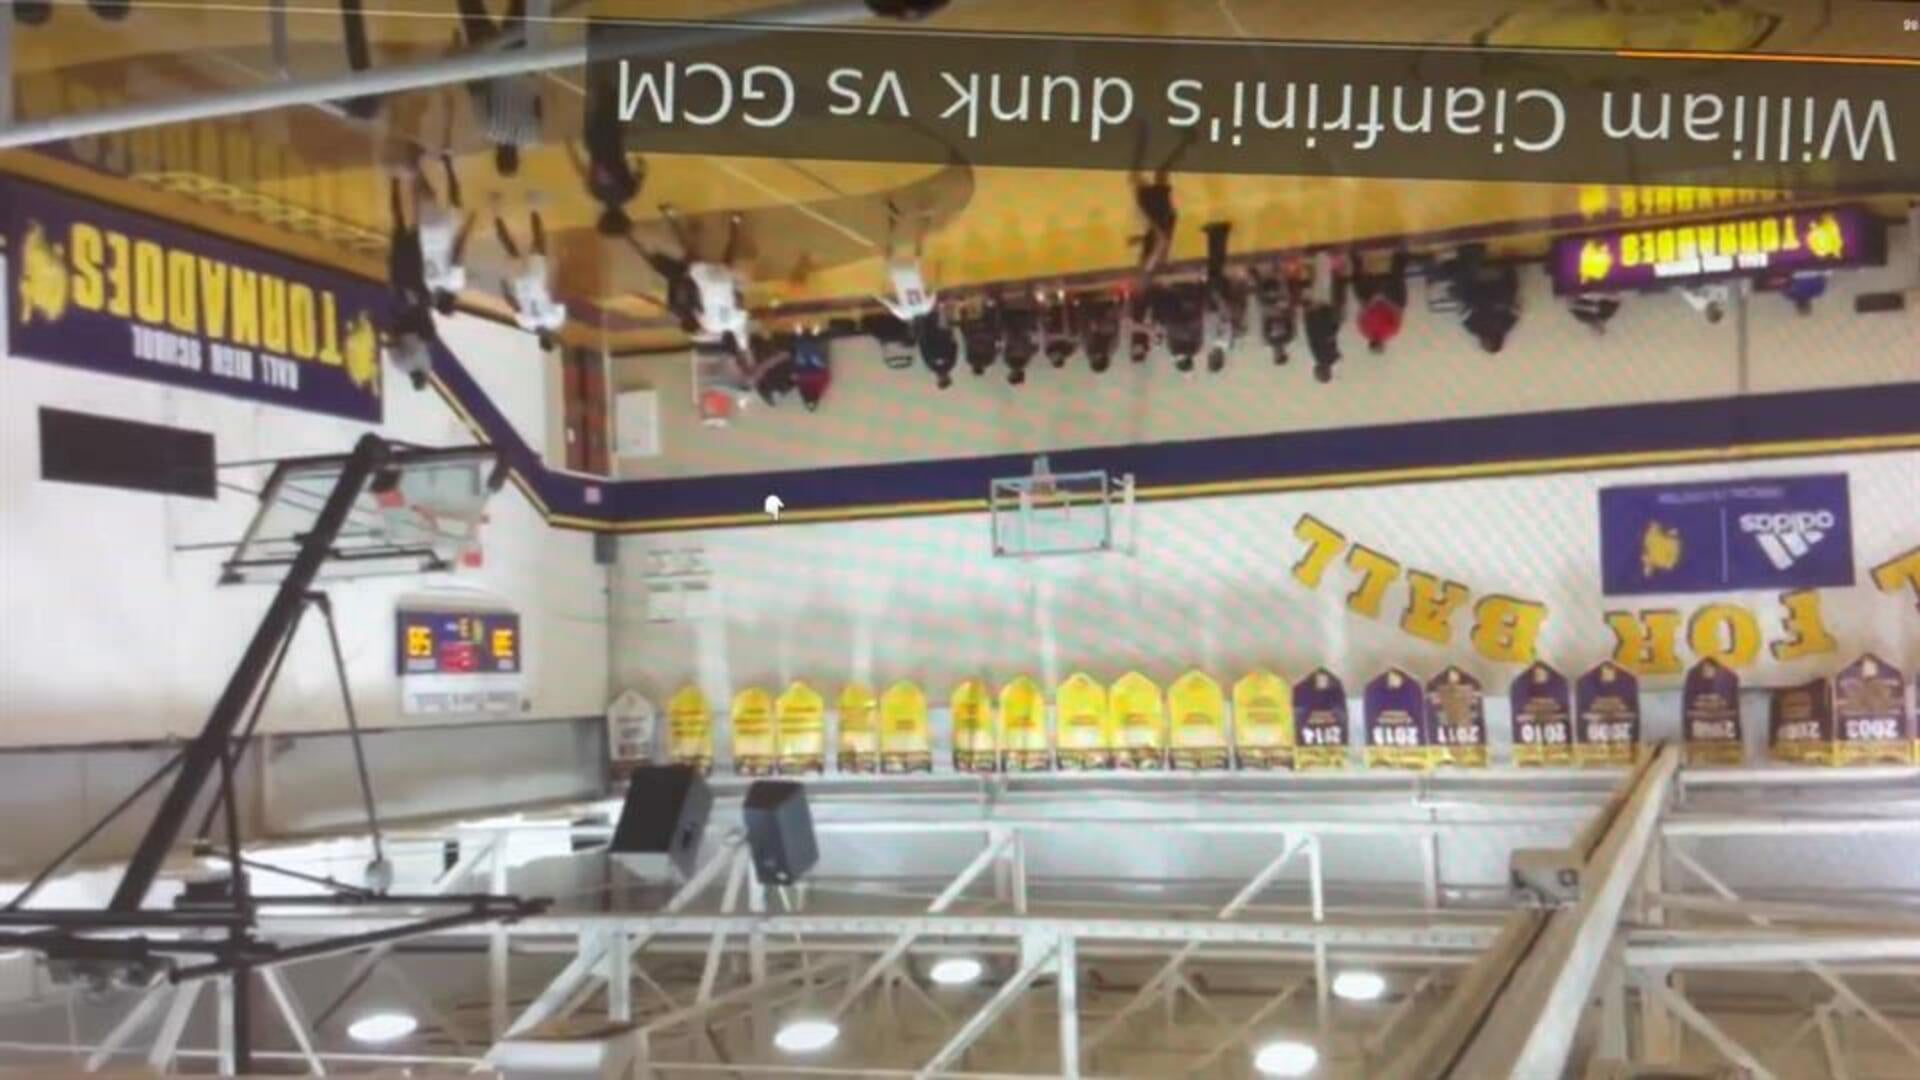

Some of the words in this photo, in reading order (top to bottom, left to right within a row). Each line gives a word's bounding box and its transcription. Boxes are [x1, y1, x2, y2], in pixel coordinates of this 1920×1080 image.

[1620, 216, 1800, 267] TORNADOES
[72, 222, 343, 367] TORNADOES
[1739, 510, 1834, 533] adidas
[1292, 512, 1547, 665] BALL
[1604, 588, 1835, 676] FOR
